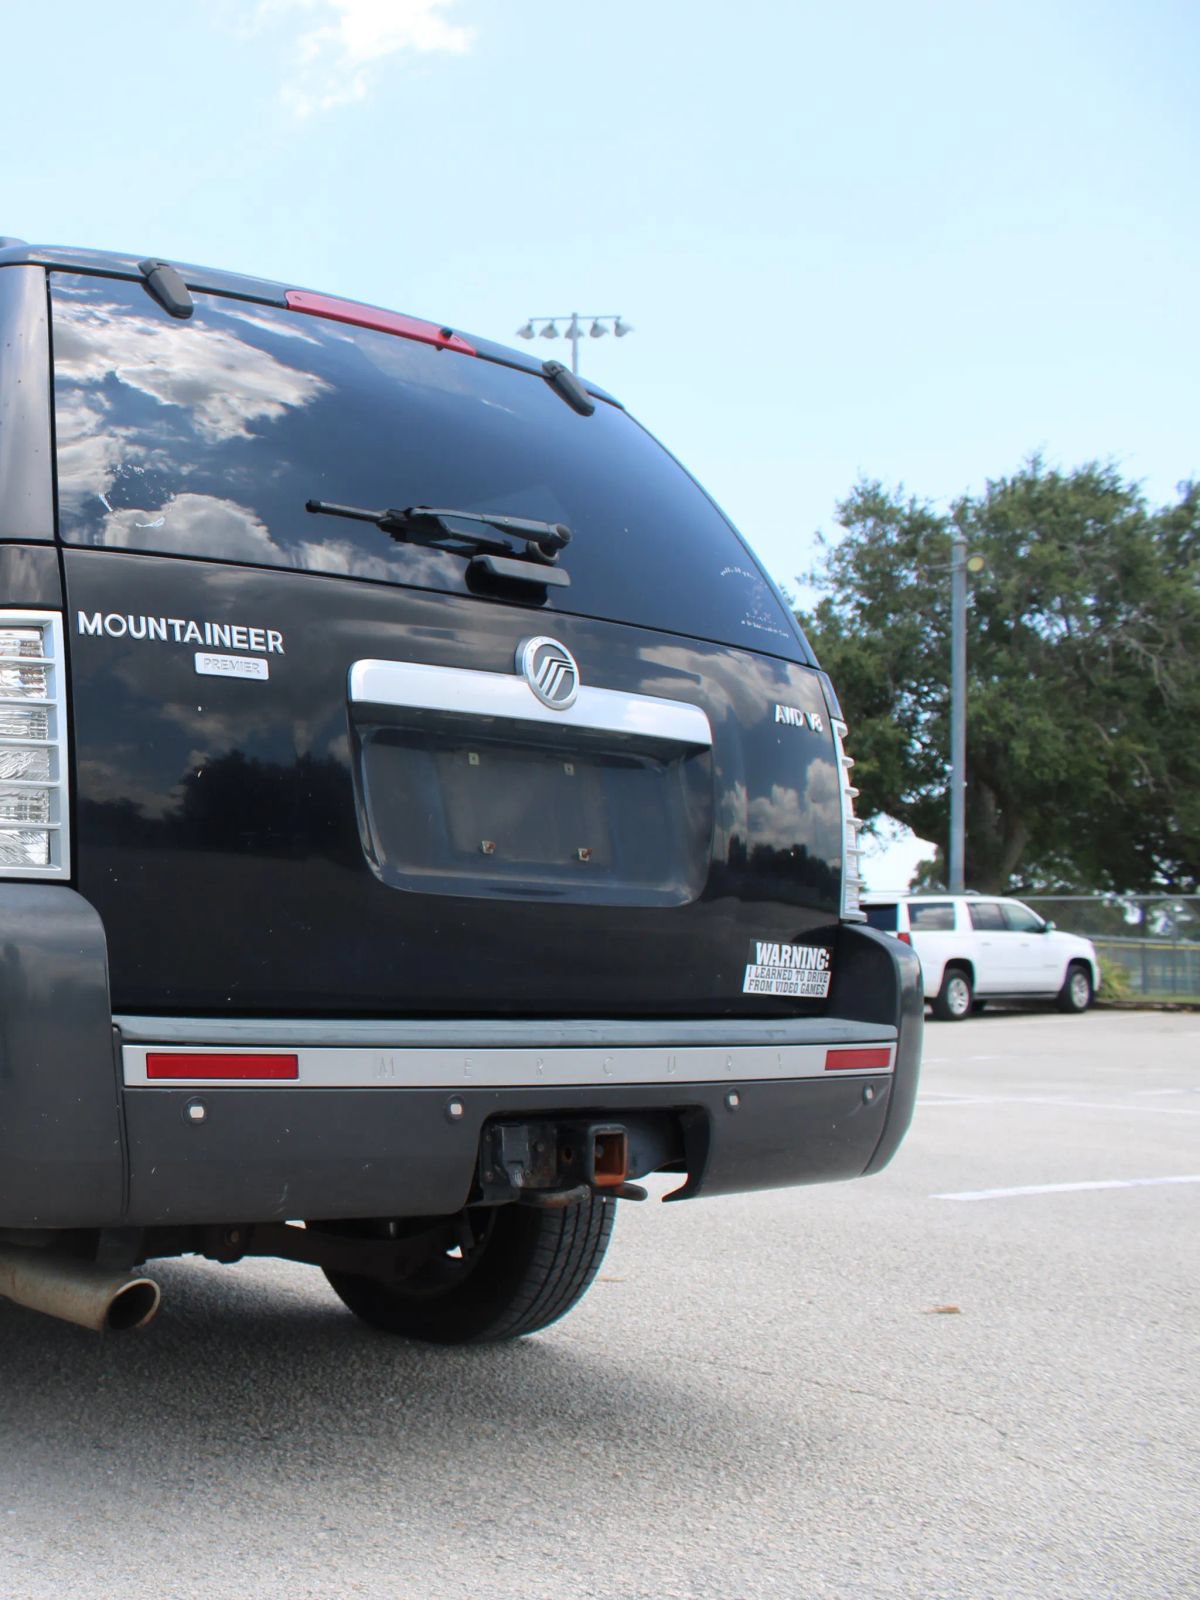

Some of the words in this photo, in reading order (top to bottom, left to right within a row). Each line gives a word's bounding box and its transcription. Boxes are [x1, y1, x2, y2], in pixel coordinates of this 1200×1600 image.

[78, 611, 285, 654] MOUNTAINEER
[203, 657, 261, 674] PREMIER
[775, 704, 803, 726] AWD
[756, 942, 830, 970] WARNING:
[754, 967, 793, 981] LEARNED
[796, 970, 805, 982] TO
[806, 971, 829, 983] DRIVE
[747, 979, 773, 992] FROM
[775, 981, 798, 994] VIDEO
[800, 983, 825, 995] GAMES
